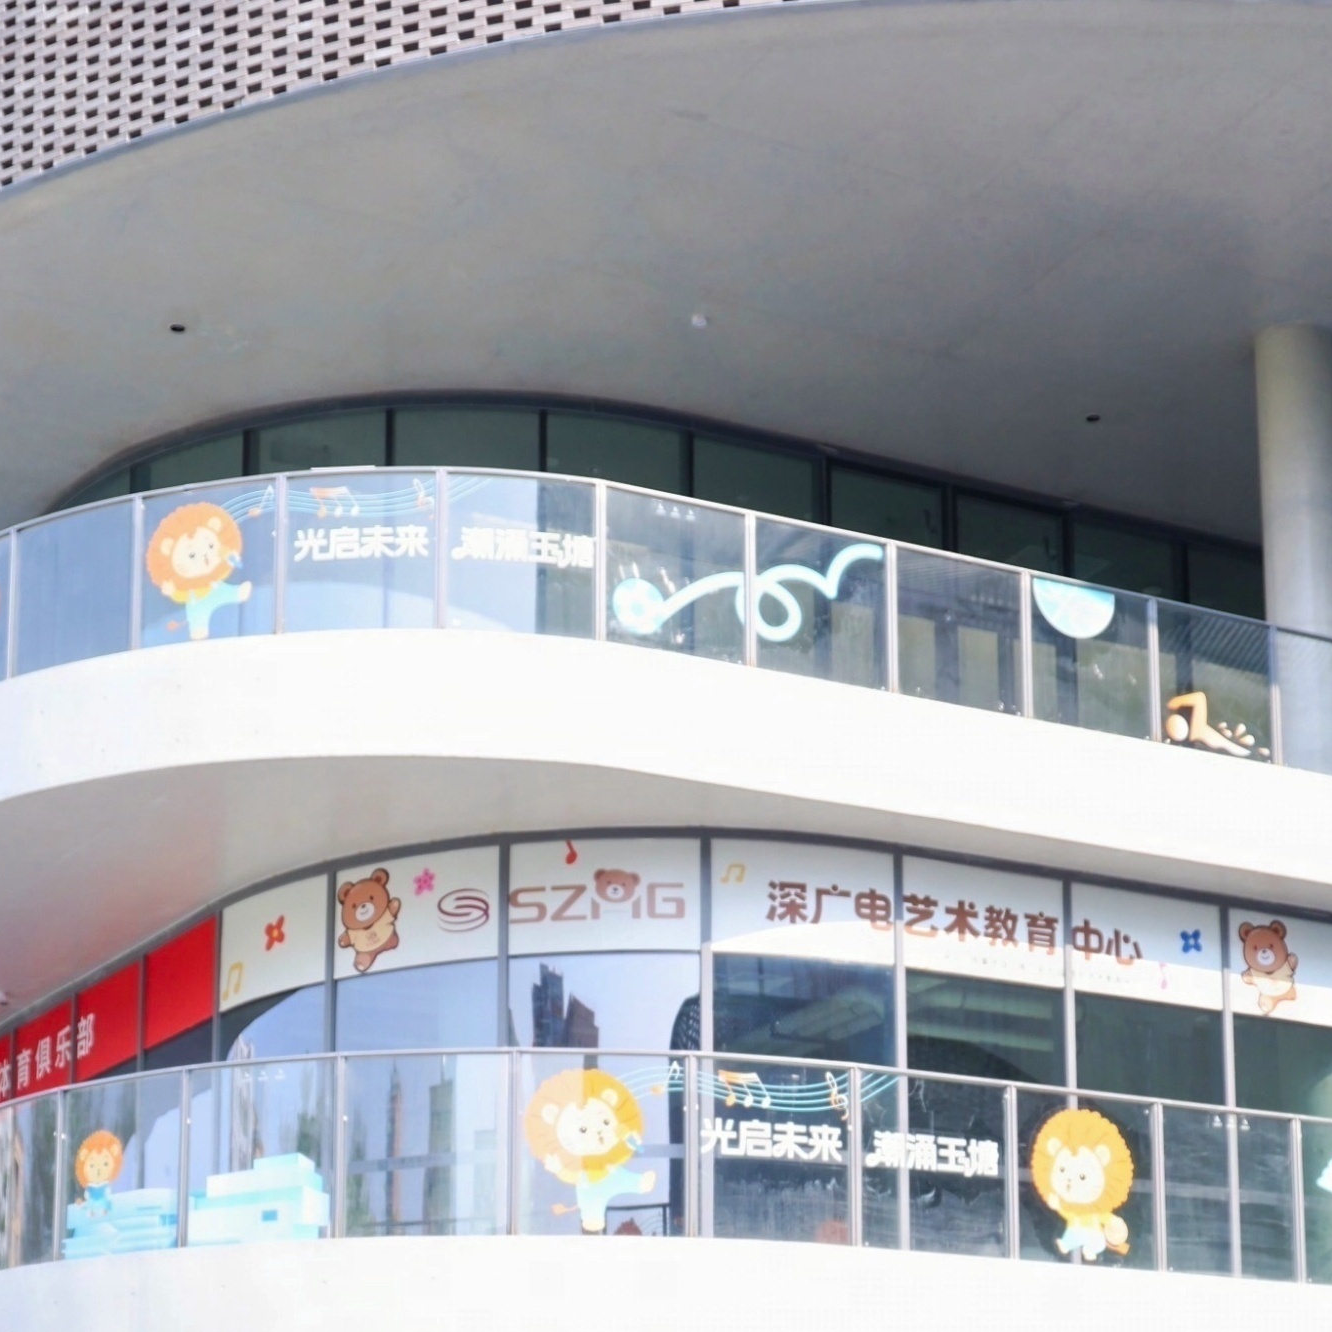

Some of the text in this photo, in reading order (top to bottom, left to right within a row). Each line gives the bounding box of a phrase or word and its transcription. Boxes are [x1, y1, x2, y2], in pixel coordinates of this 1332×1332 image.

[294, 523, 430, 562] 光启未来
[765, 880, 1143, 967] 深广电艺术教育中心
[700, 1116, 999, 1178] 光启未来 潮涌玉塘
